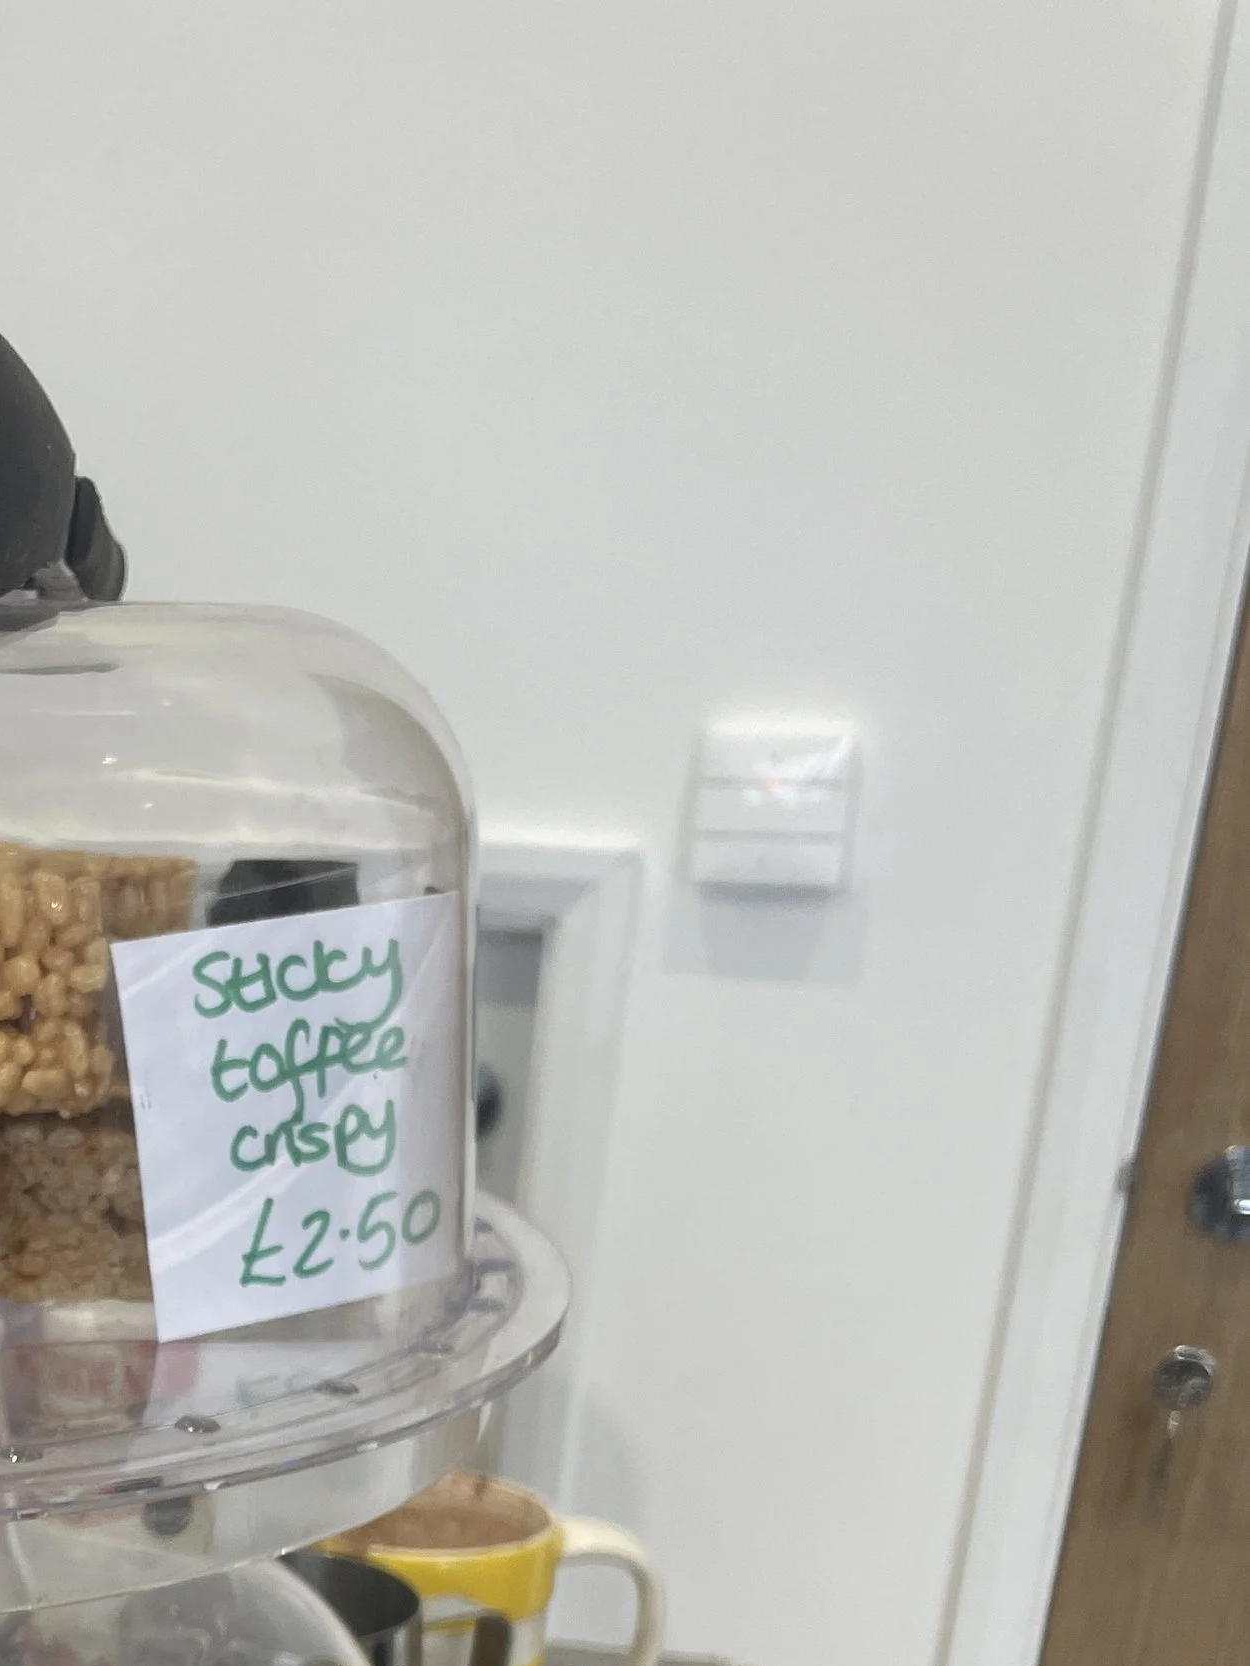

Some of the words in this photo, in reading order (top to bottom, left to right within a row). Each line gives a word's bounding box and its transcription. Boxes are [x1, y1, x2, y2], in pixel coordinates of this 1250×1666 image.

[192, 938, 404, 1030] Sticky
[210, 1017, 409, 1124] toffee
[239, 1189, 442, 1288] £2.50
